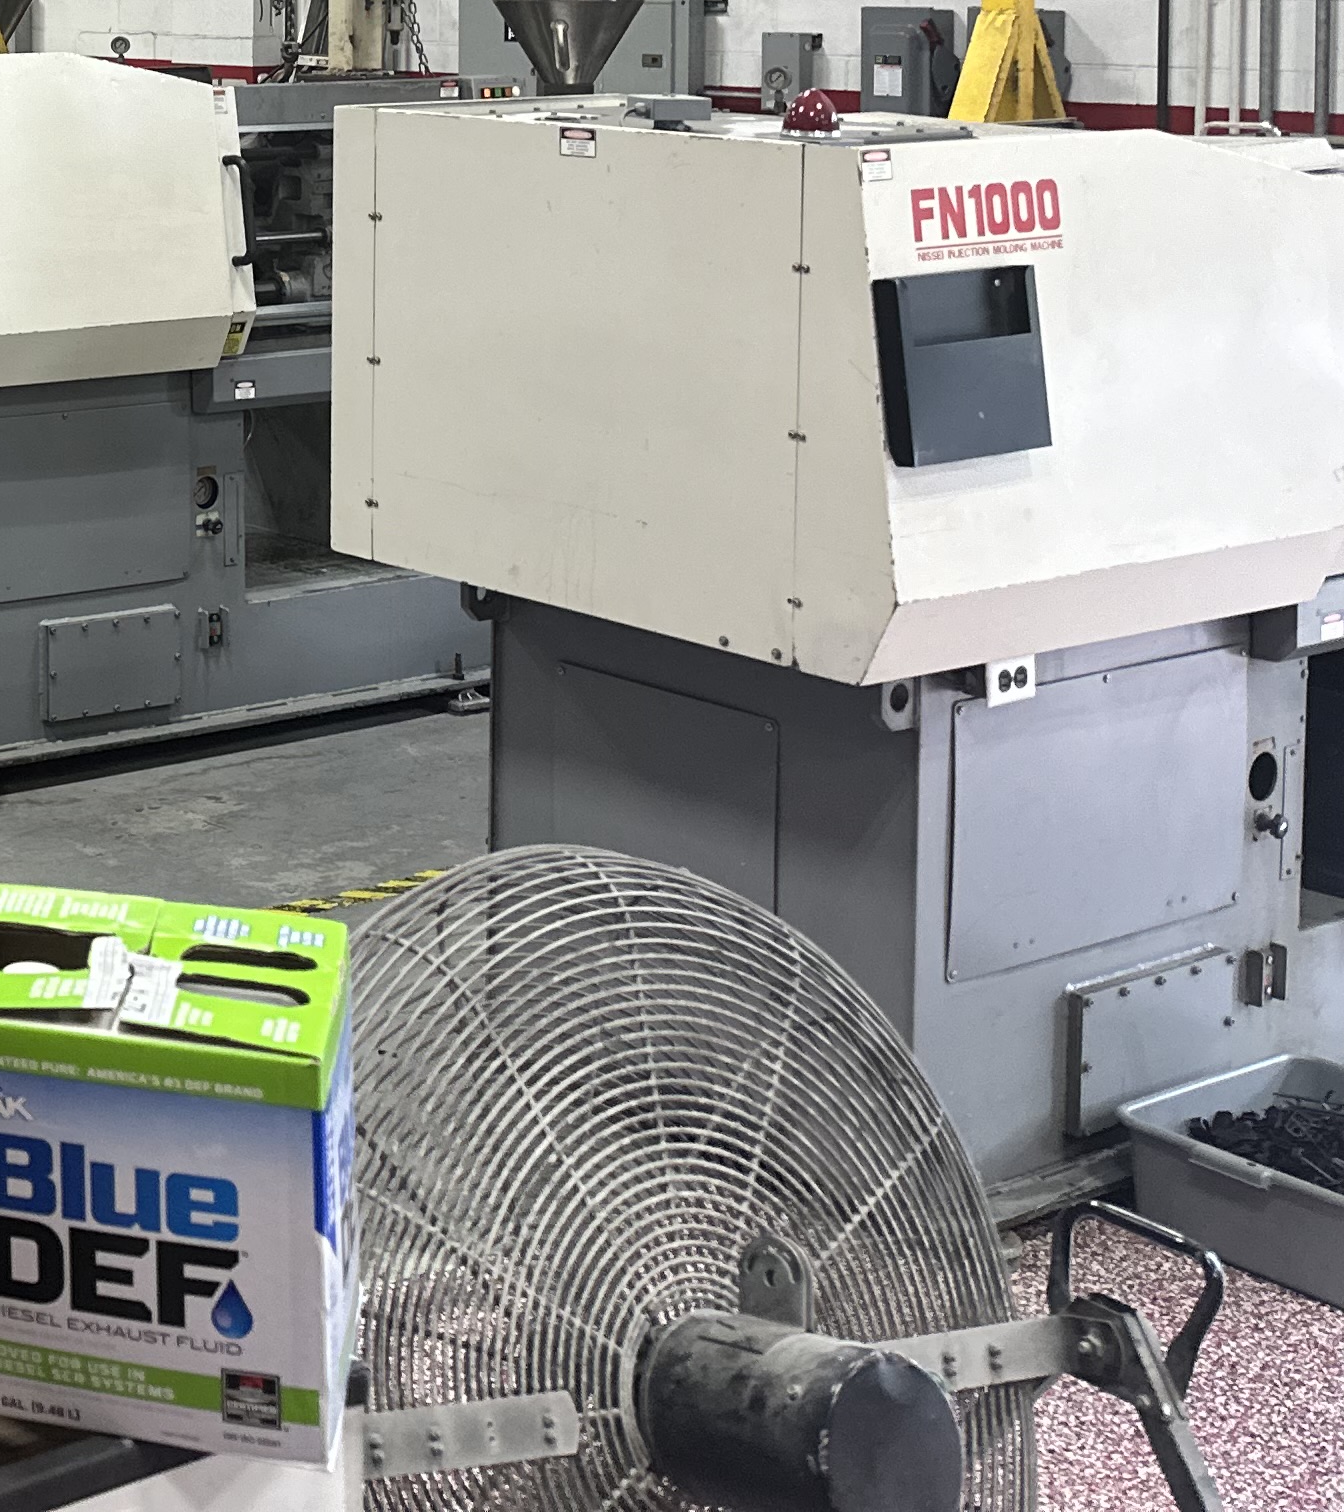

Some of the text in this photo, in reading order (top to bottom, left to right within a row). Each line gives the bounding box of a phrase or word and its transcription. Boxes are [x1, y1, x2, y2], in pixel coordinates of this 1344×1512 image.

[911, 178, 1061, 242] FN1000
[947, 247, 990, 259] INJECTION
[993, 243, 1028, 255] MOLDING
[1030, 239, 1064, 251] MACHINE
[214, 1083, 265, 1100] BRAND
[66, 1316, 170, 1347] EXHAUST
[175, 1334, 244, 1357] FLUID
[48, 1354, 81, 1370] FOR
[87, 1360, 120, 1378] USE
[127, 1367, 145, 1382] IN
[90, 1375, 175, 1401] SYSTEMS
